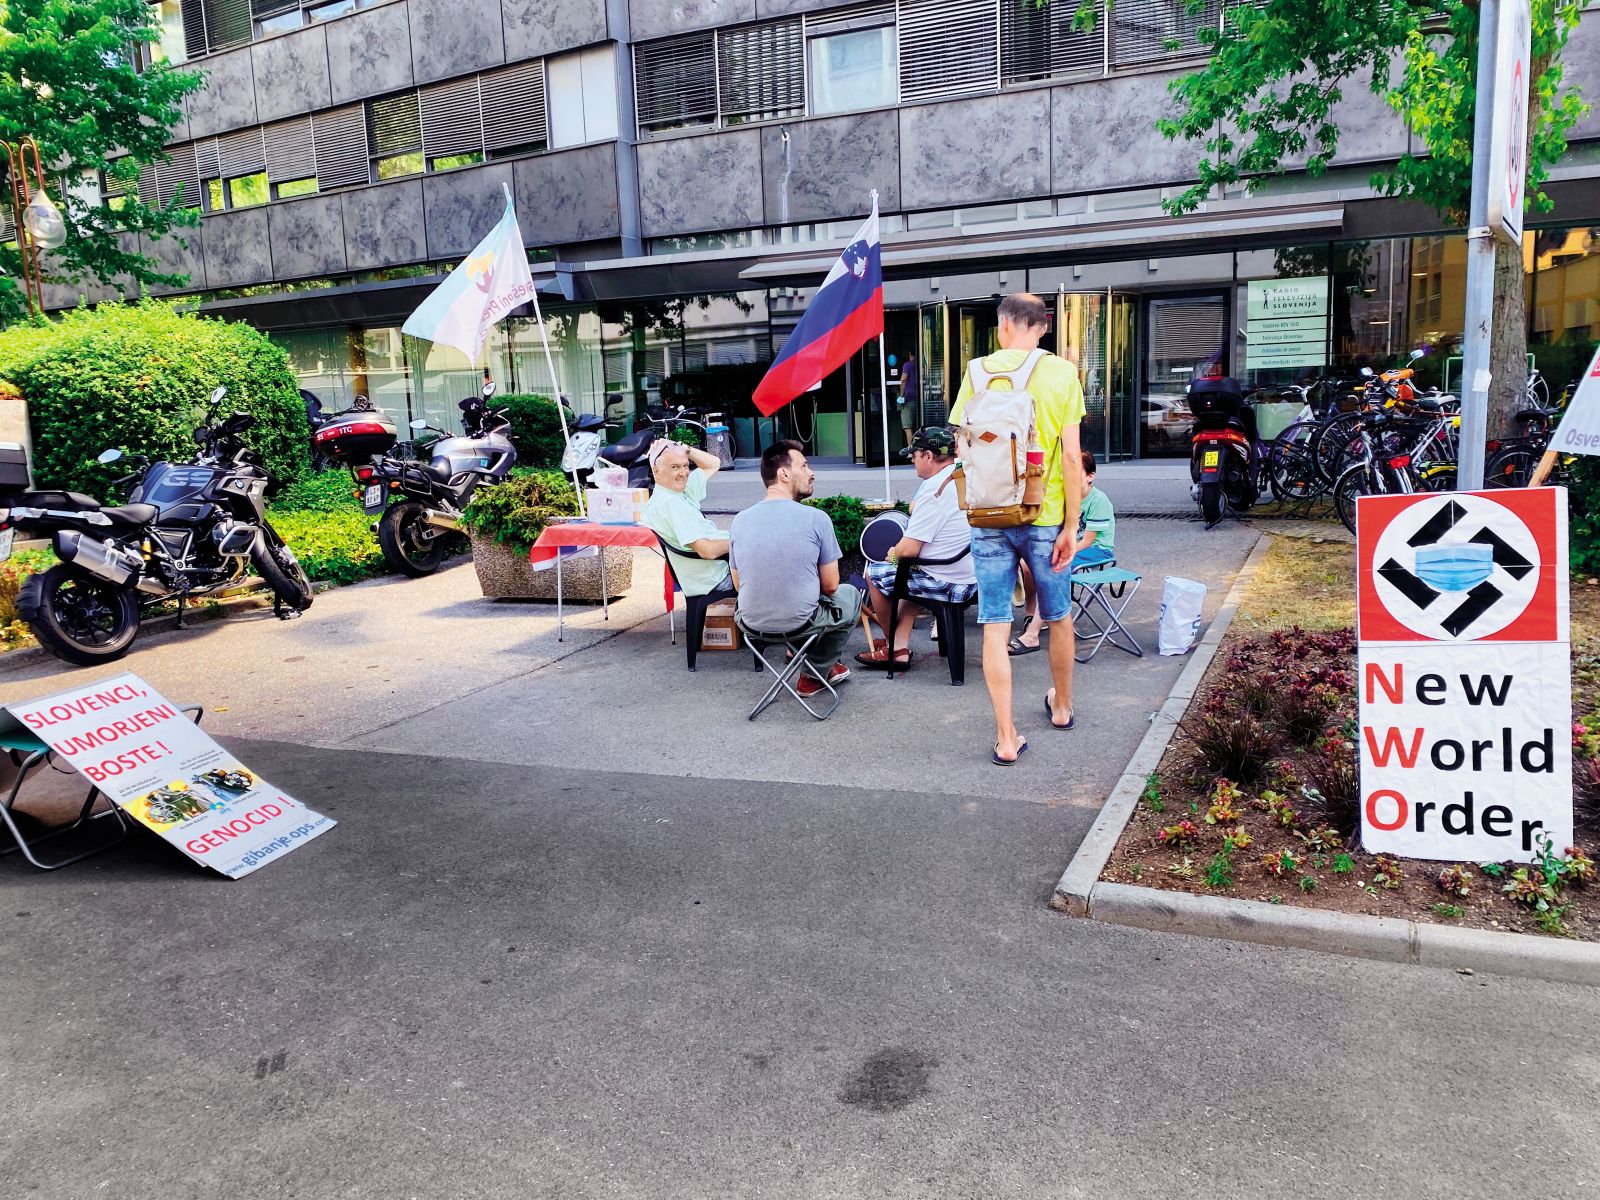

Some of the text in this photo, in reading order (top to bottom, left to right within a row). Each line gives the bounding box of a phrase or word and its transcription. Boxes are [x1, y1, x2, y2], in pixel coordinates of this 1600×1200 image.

[1273, 301, 1317, 309] SLOVENIJA
[1566, 428, 1600, 448] Osve
[22, 684, 148, 729] SLOVENCI,
[1365, 662, 1514, 707] New
[53, 704, 177, 756] UMORJENI
[1363, 726, 1555, 774] World
[186, 803, 283, 855] GENOCID
[1365, 789, 1544, 851] Order
